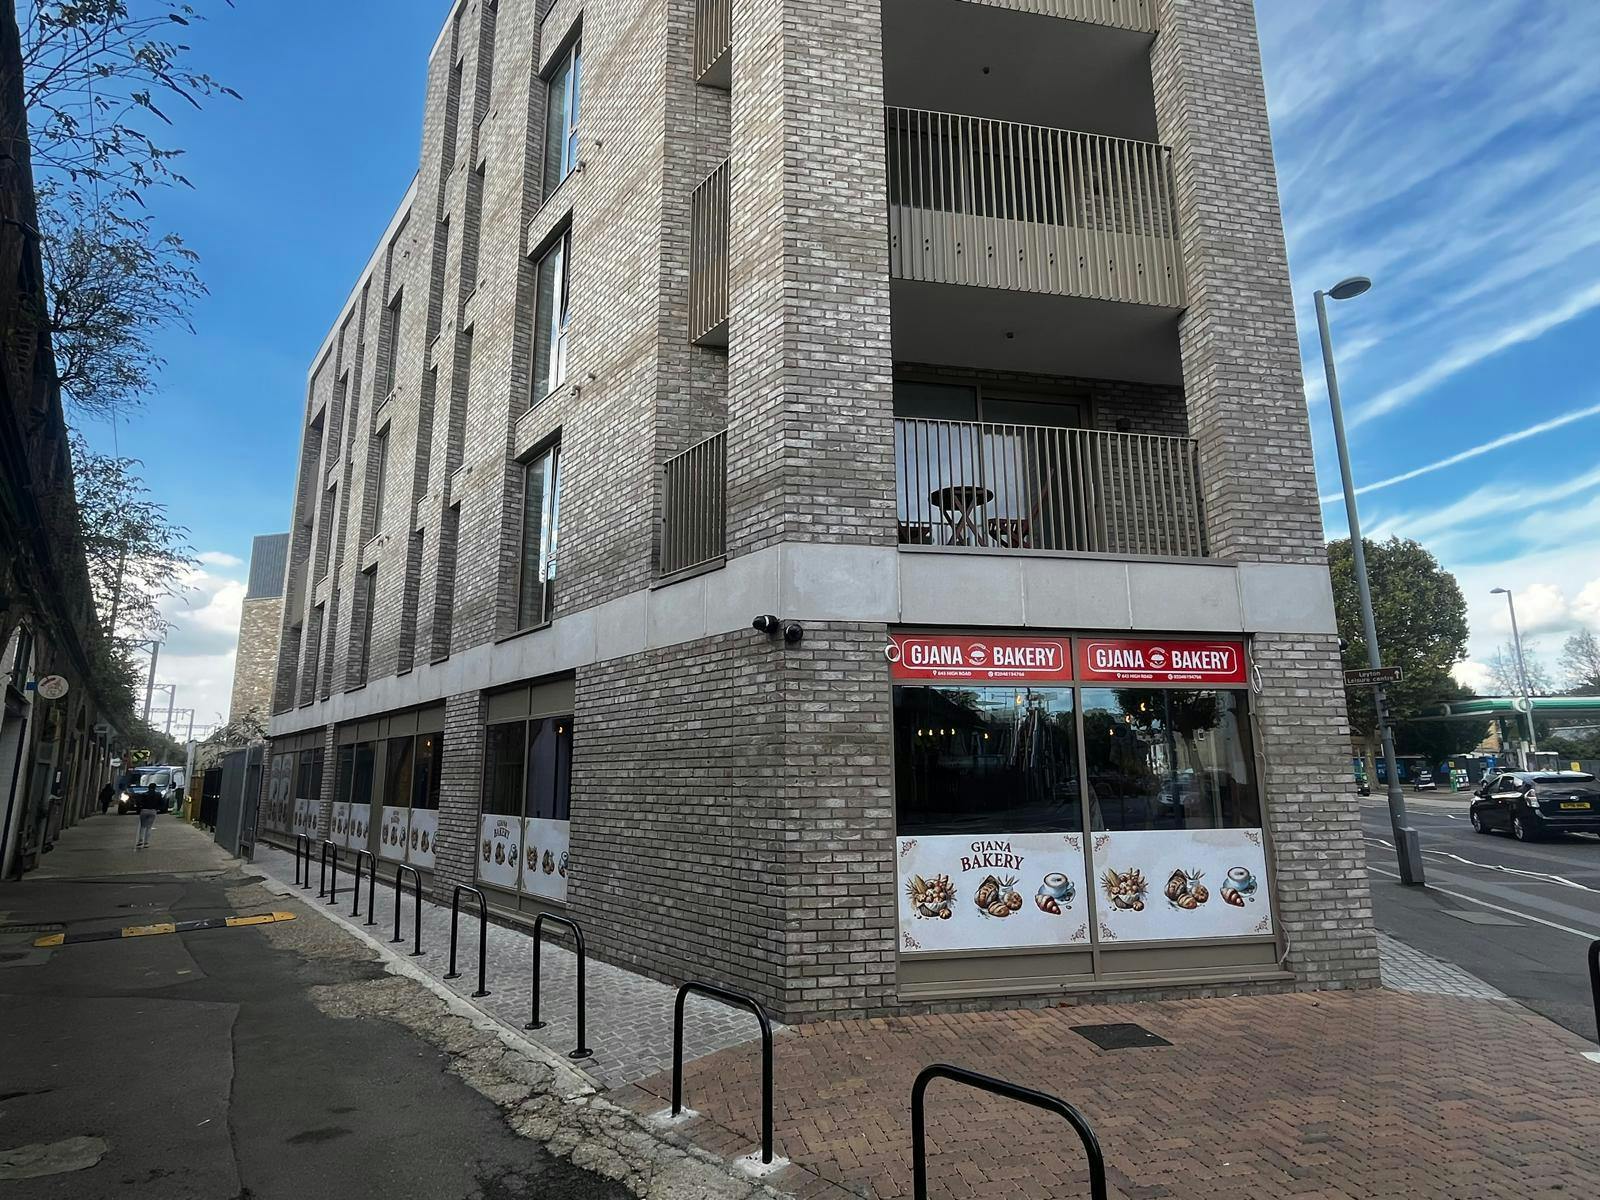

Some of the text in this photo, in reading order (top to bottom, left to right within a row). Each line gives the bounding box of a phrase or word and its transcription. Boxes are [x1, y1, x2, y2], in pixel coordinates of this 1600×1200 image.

[911, 644, 1055, 666] GJANA BAKERY
[1096, 649, 1229, 669] GJANA BAKERY
[960, 853, 1024, 872] BAKERY
